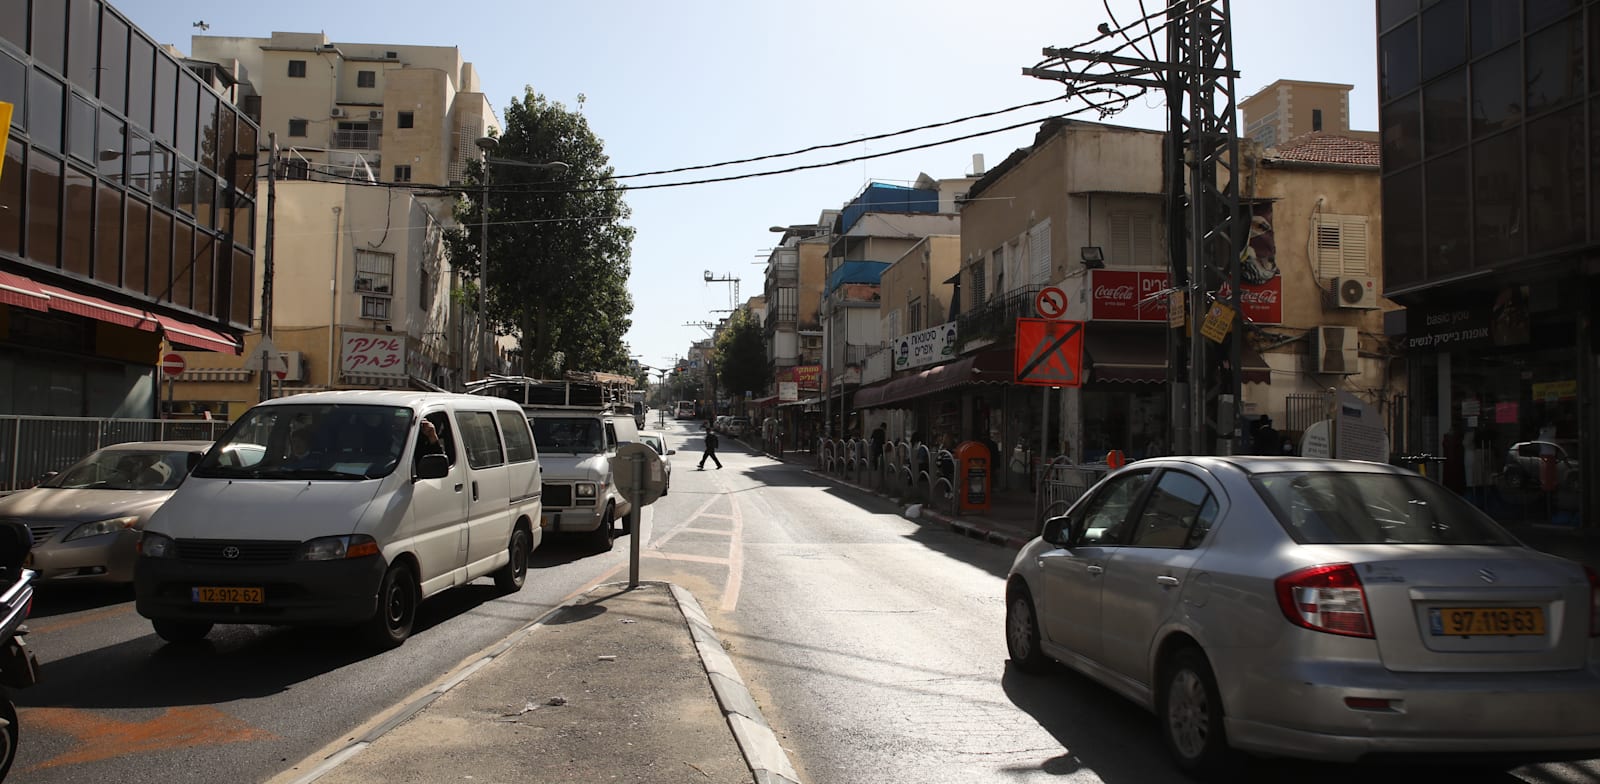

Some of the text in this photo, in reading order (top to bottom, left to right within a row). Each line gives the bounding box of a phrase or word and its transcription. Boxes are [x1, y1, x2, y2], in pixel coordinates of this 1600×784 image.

[1143, 278, 1168, 291] פרים
[1426, 311, 1469, 326] basic you
[1409, 332, 1433, 347] לנשים
[1462, 327, 1489, 340] אופנת
[347, 337, 399, 353] ארנקי
[346, 354, 401, 370] יצחקי
